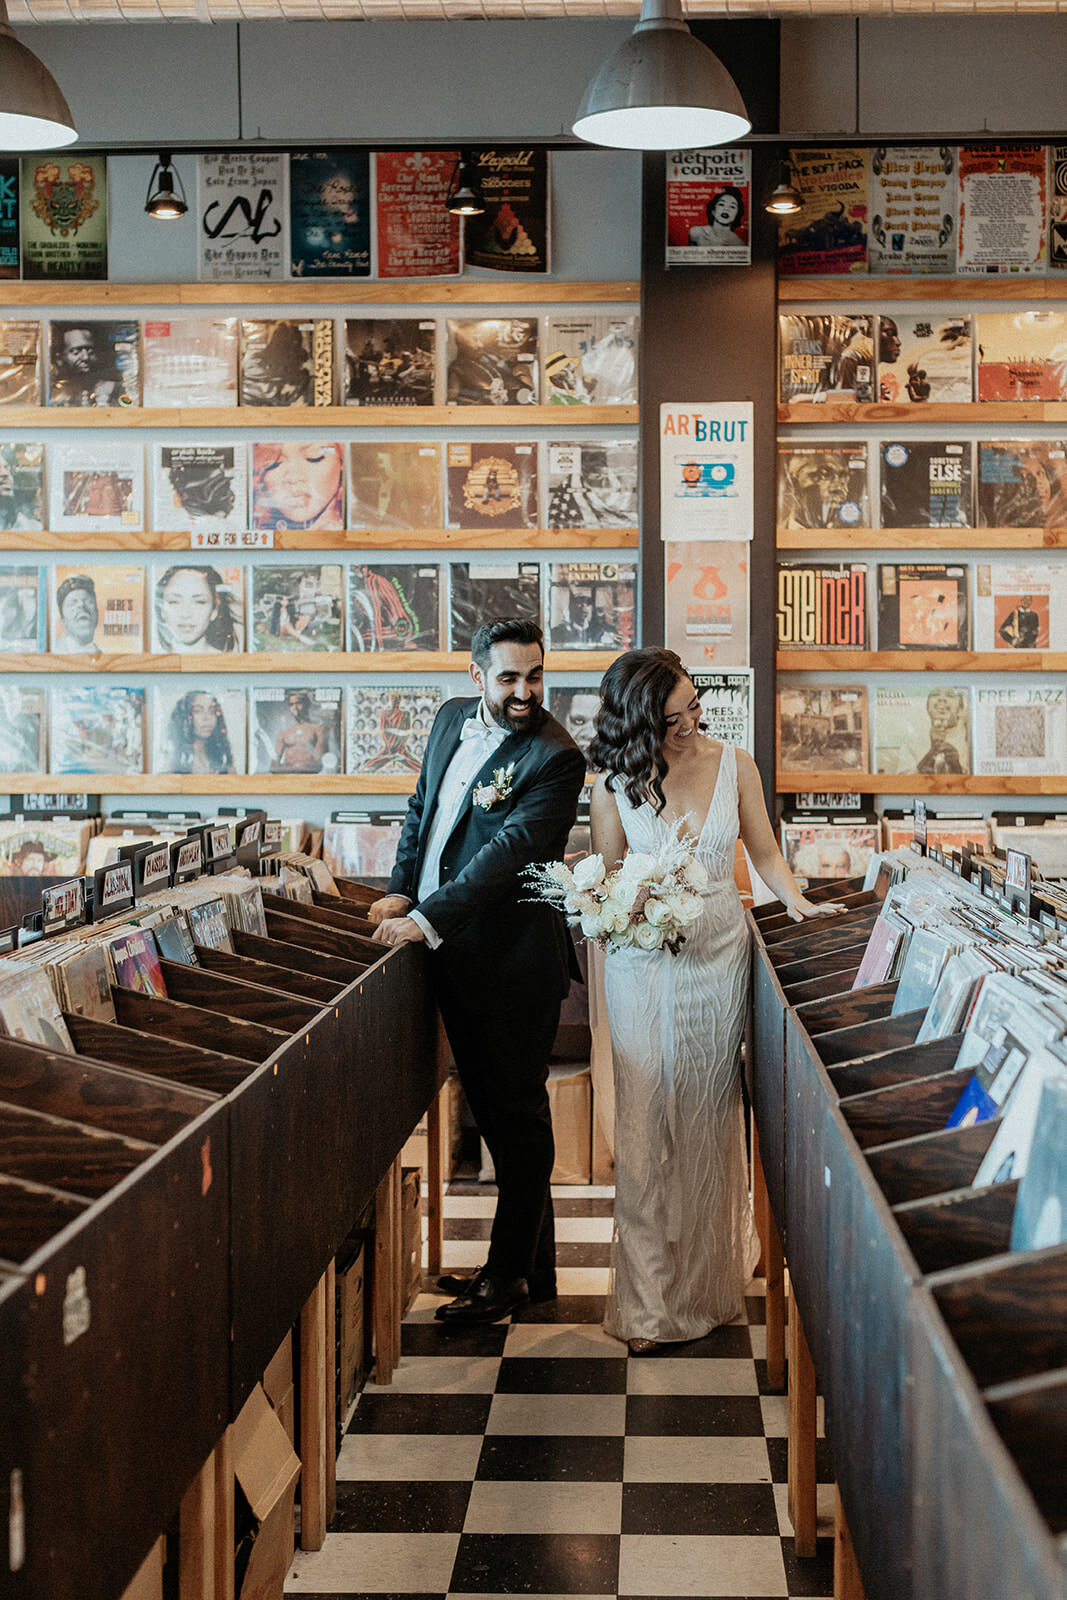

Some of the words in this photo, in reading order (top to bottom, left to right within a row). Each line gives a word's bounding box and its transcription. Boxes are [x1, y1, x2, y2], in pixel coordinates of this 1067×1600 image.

[671, 151, 736, 164] detroit
[681, 163, 744, 176] cobras
[663, 414, 702, 436] ART
[696, 420, 748, 442] BRUT
[929, 464, 962, 481] ELSE
[978, 688, 1017, 703] FREE
[1027, 688, 1065, 703] JAZZ
